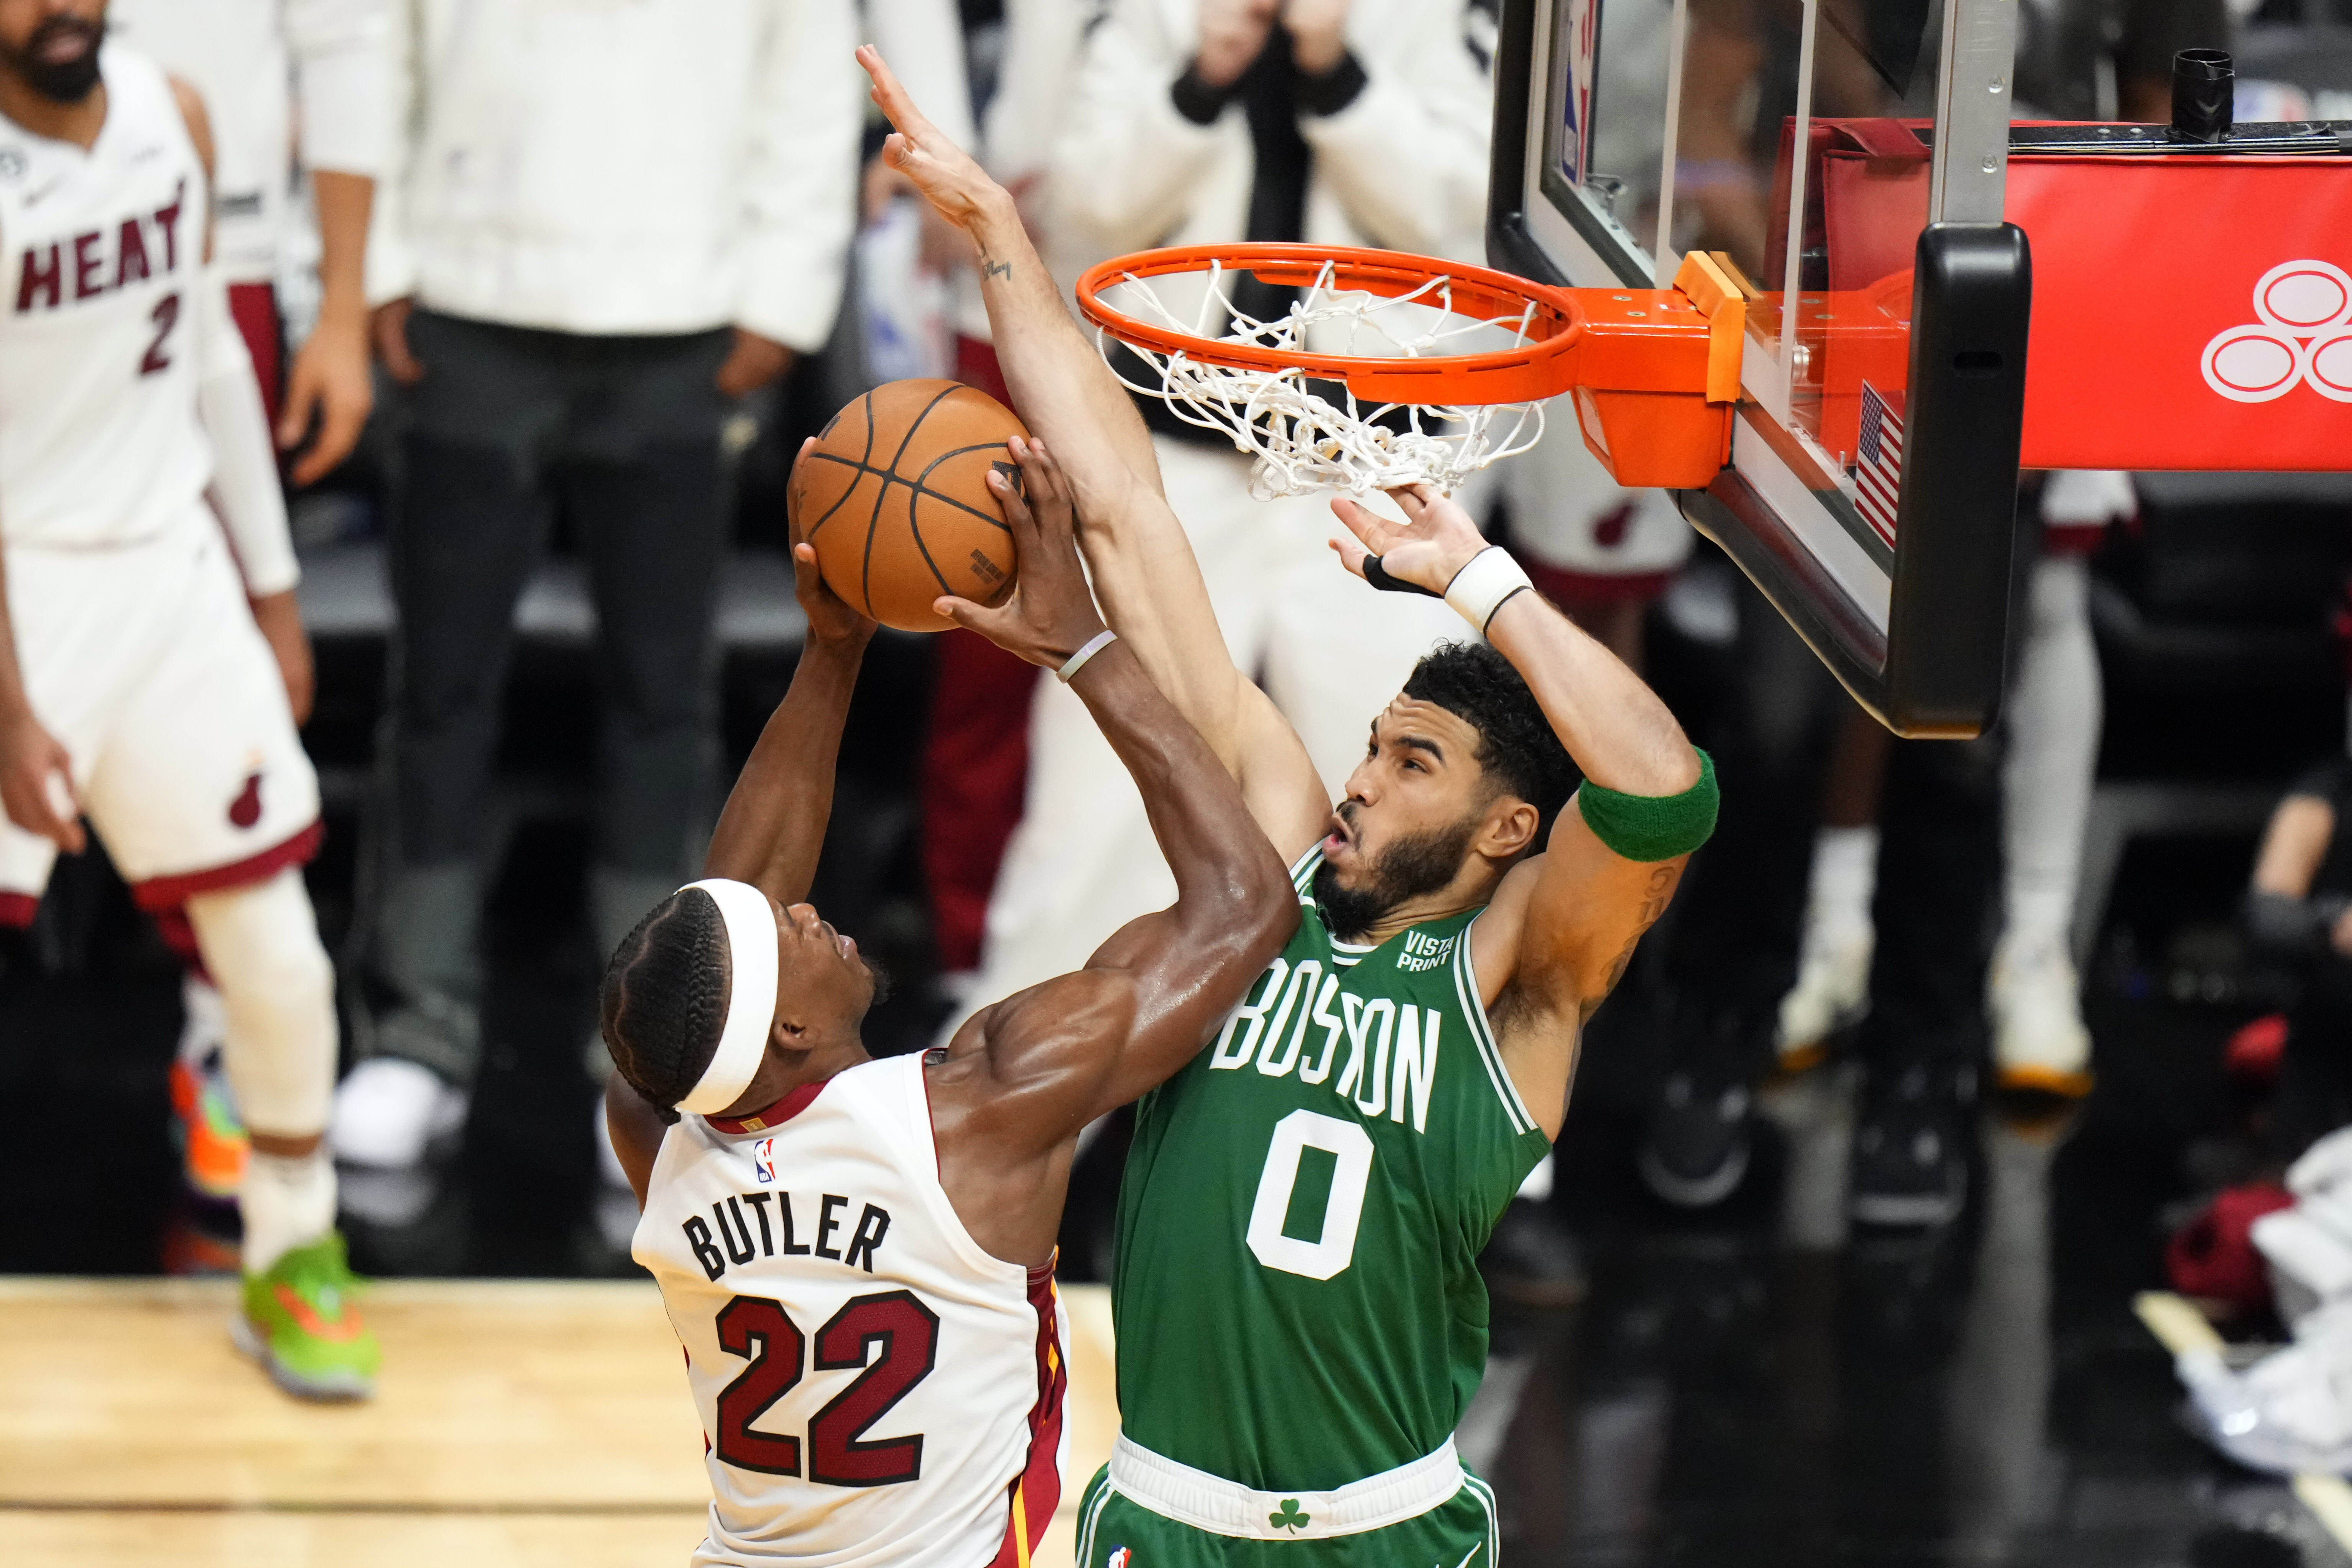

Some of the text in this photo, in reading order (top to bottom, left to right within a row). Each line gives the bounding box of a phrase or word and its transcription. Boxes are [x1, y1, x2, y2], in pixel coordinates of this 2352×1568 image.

[16, 179, 185, 310] HEAT
[139, 293, 180, 375] 2
[1396, 951, 1450, 971] PRINT
[1405, 930, 1455, 956] VISTA
[759, 1172, 769, 1181] NBA
[1246, 1108, 1374, 1281] 0
[682, 1191, 891, 1282] BUTLER
[715, 1289, 940, 1487] 22
